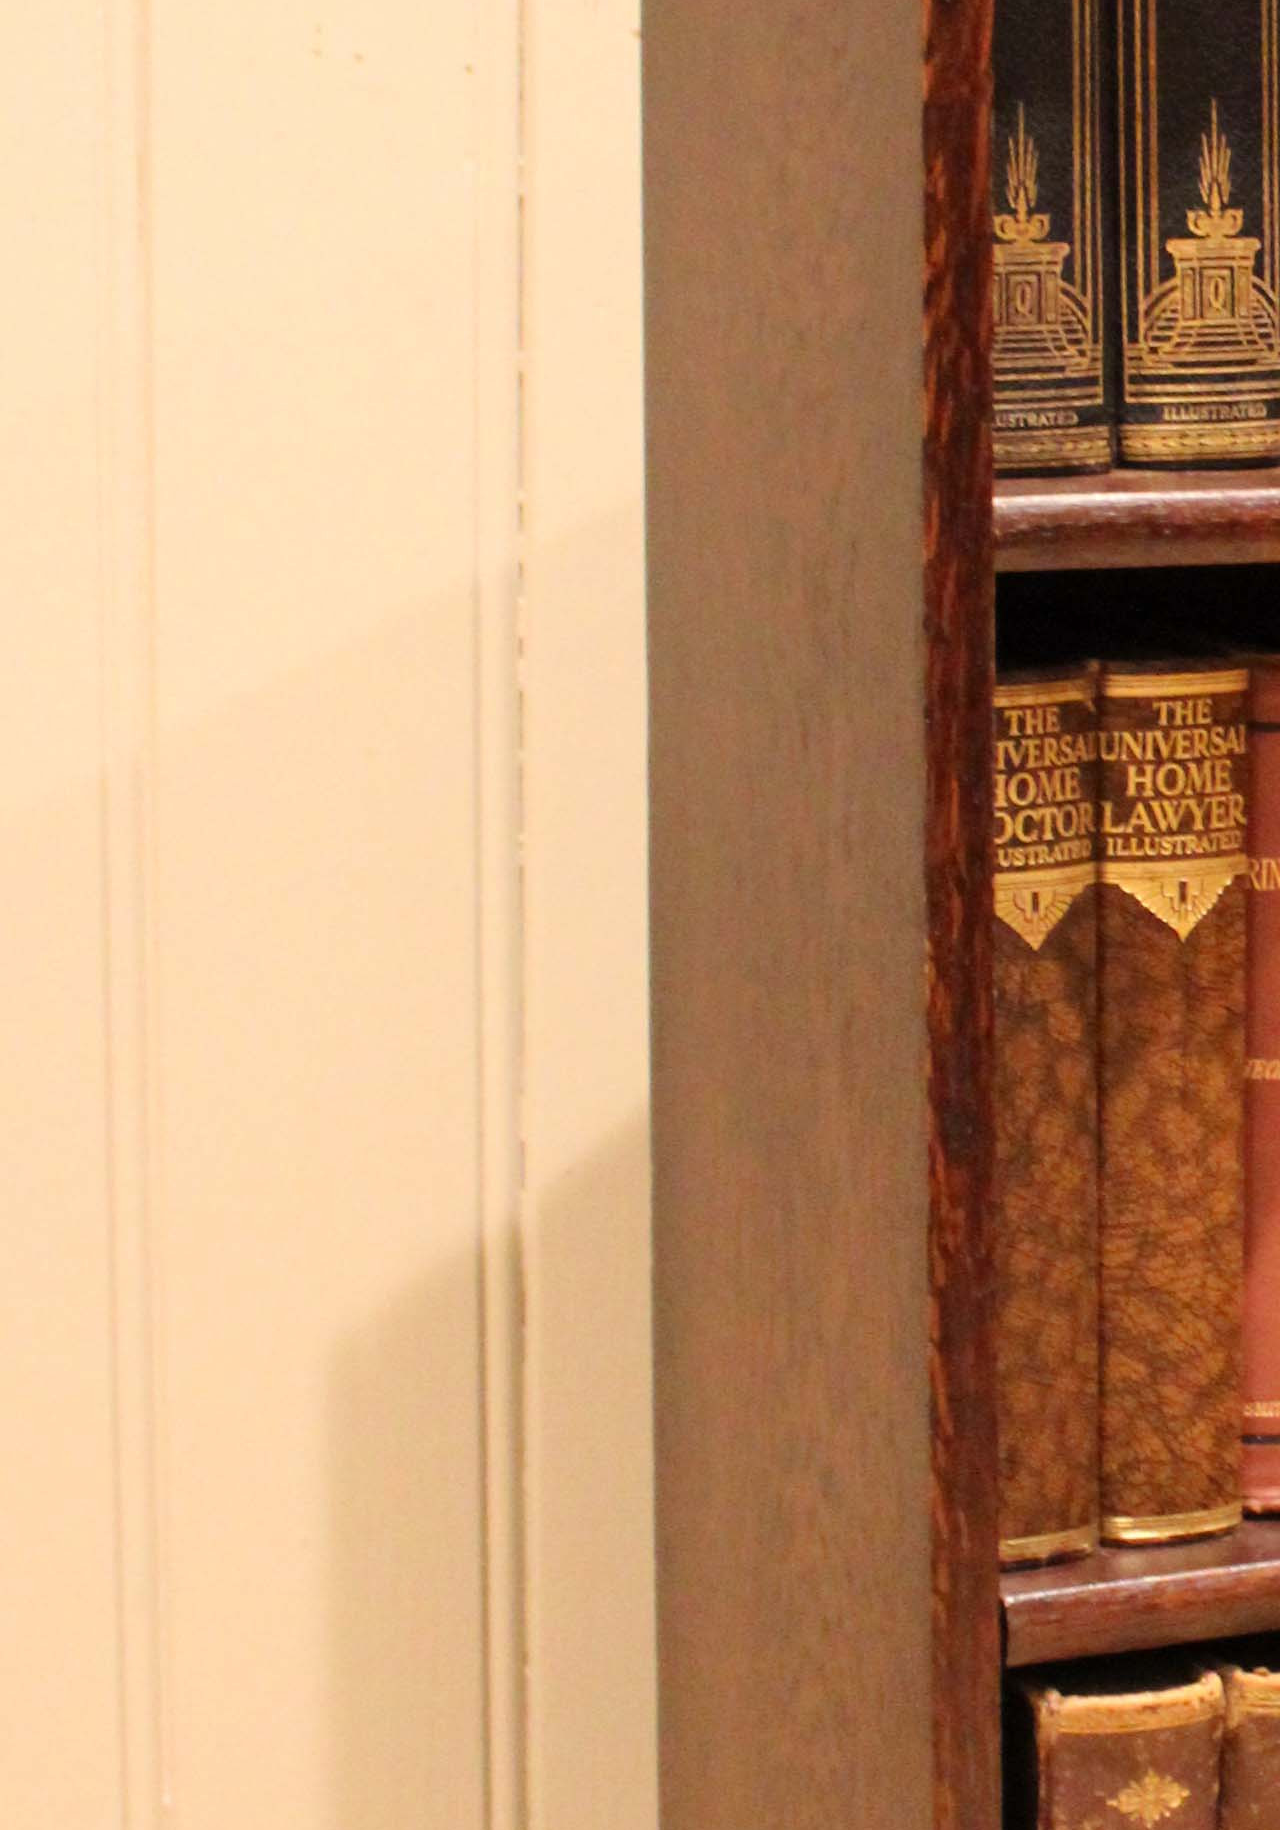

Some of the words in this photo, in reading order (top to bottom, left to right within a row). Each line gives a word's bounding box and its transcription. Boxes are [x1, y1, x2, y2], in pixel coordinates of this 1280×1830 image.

[1004, 707, 1060, 737] THE
[1153, 698, 1213, 728] THE
[1100, 723, 1246, 763] UNIVERSAL
[1125, 758, 1233, 798] HOME
[1102, 793, 1248, 835] LAWYER
[1106, 831, 1242, 858] ILLUSTRATED
